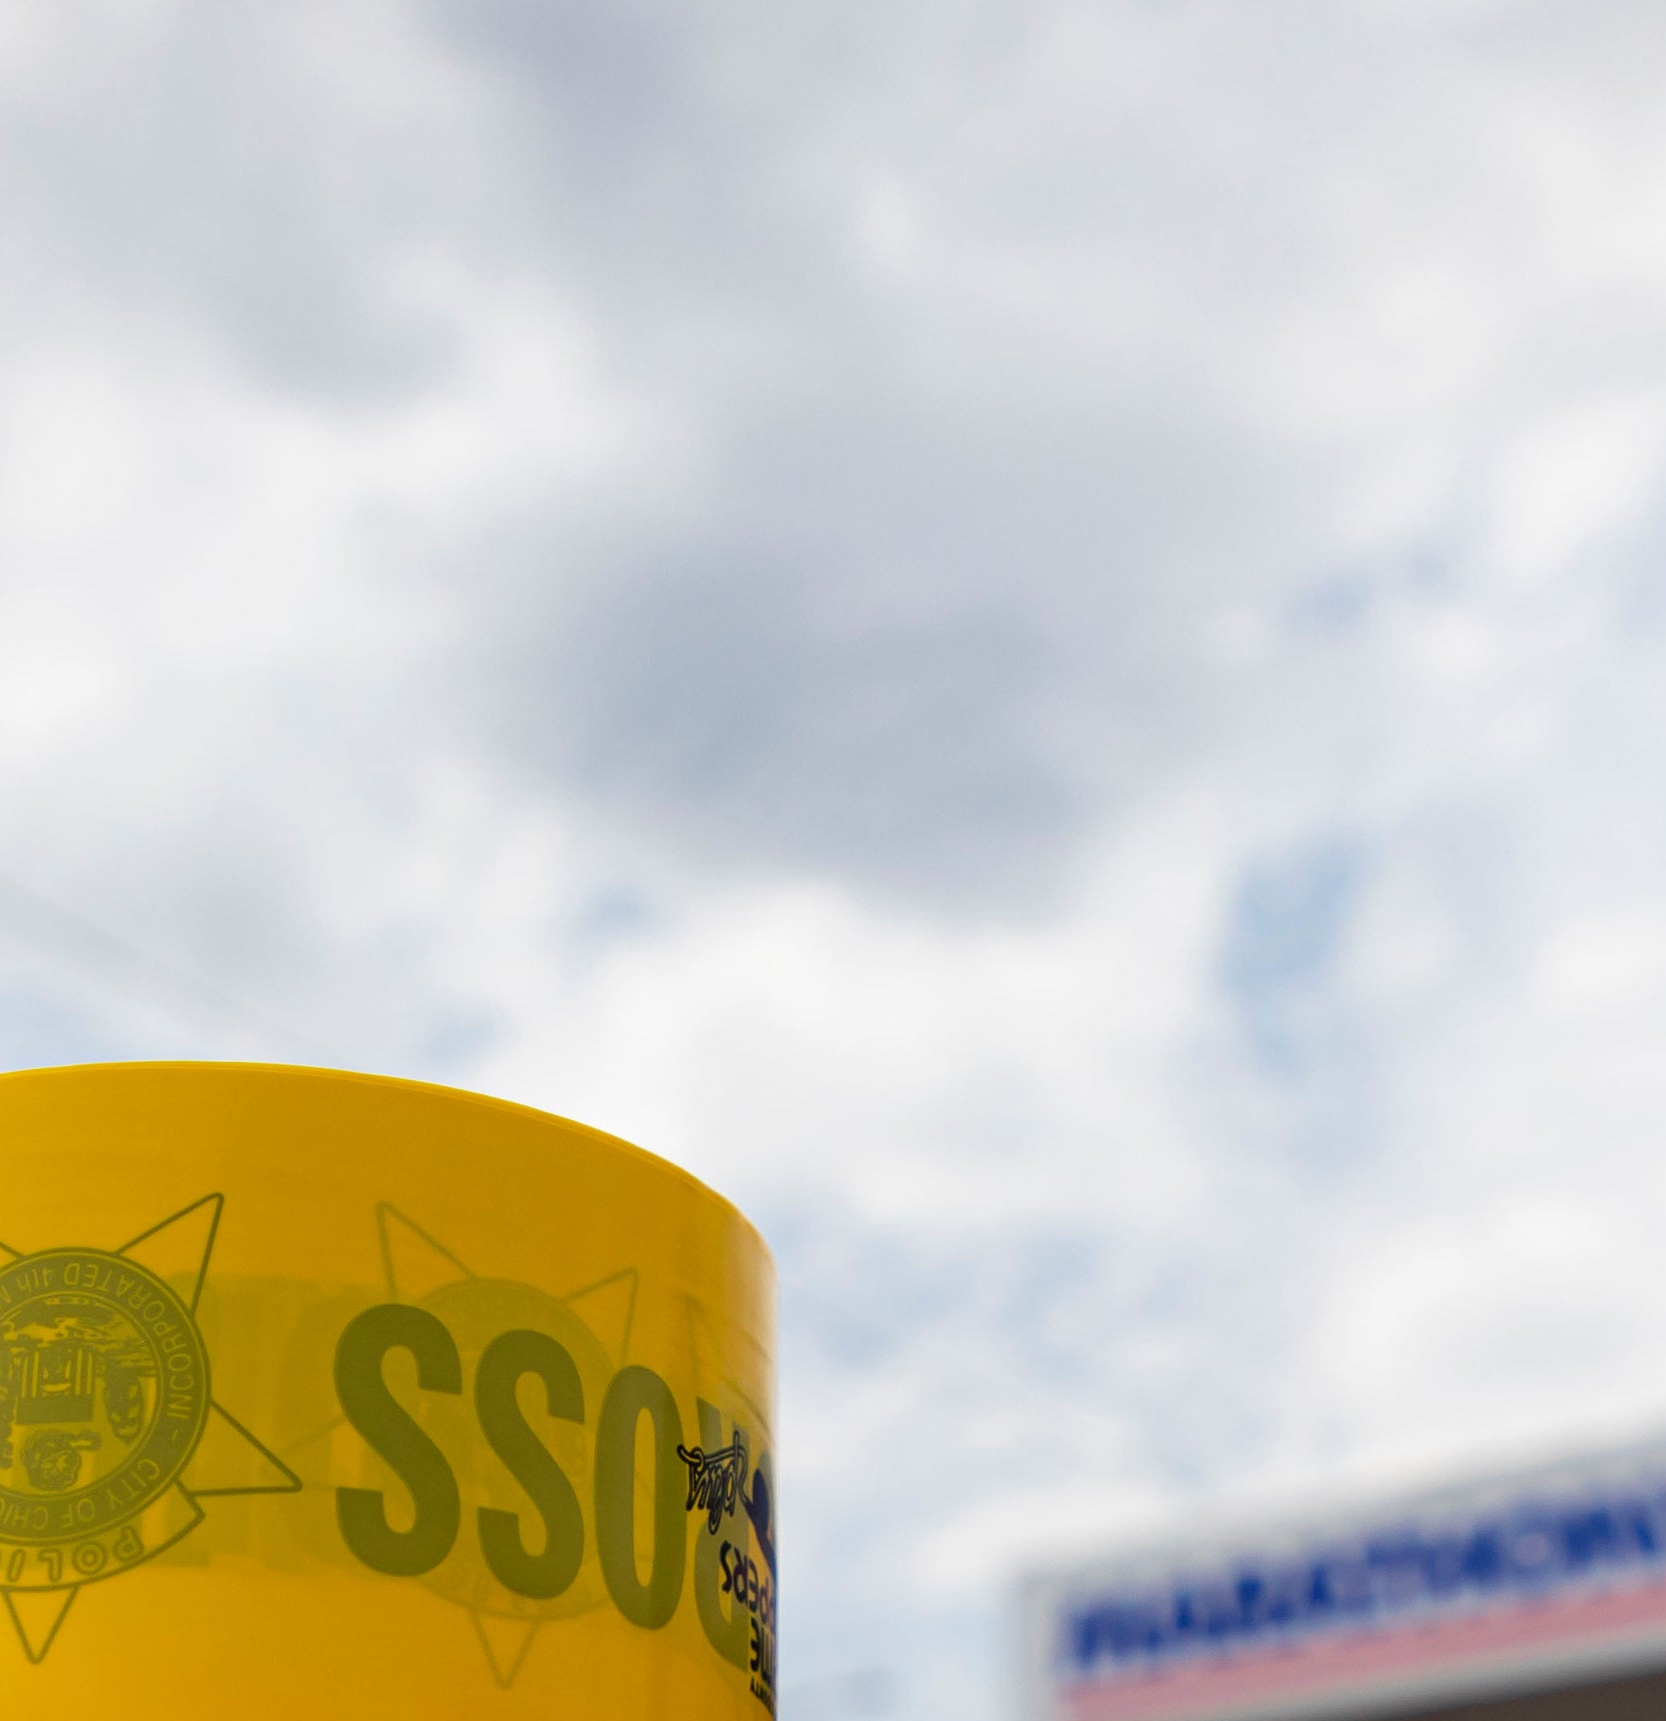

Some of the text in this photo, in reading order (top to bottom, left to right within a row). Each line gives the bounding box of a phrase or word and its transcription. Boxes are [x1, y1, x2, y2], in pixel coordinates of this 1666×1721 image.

[63, 1262, 196, 1421] INCORPORATED
[61, 1498, 96, 1530] OF
[108, 1458, 161, 1510] CITY
[334, 1303, 776, 1672] ROSS
